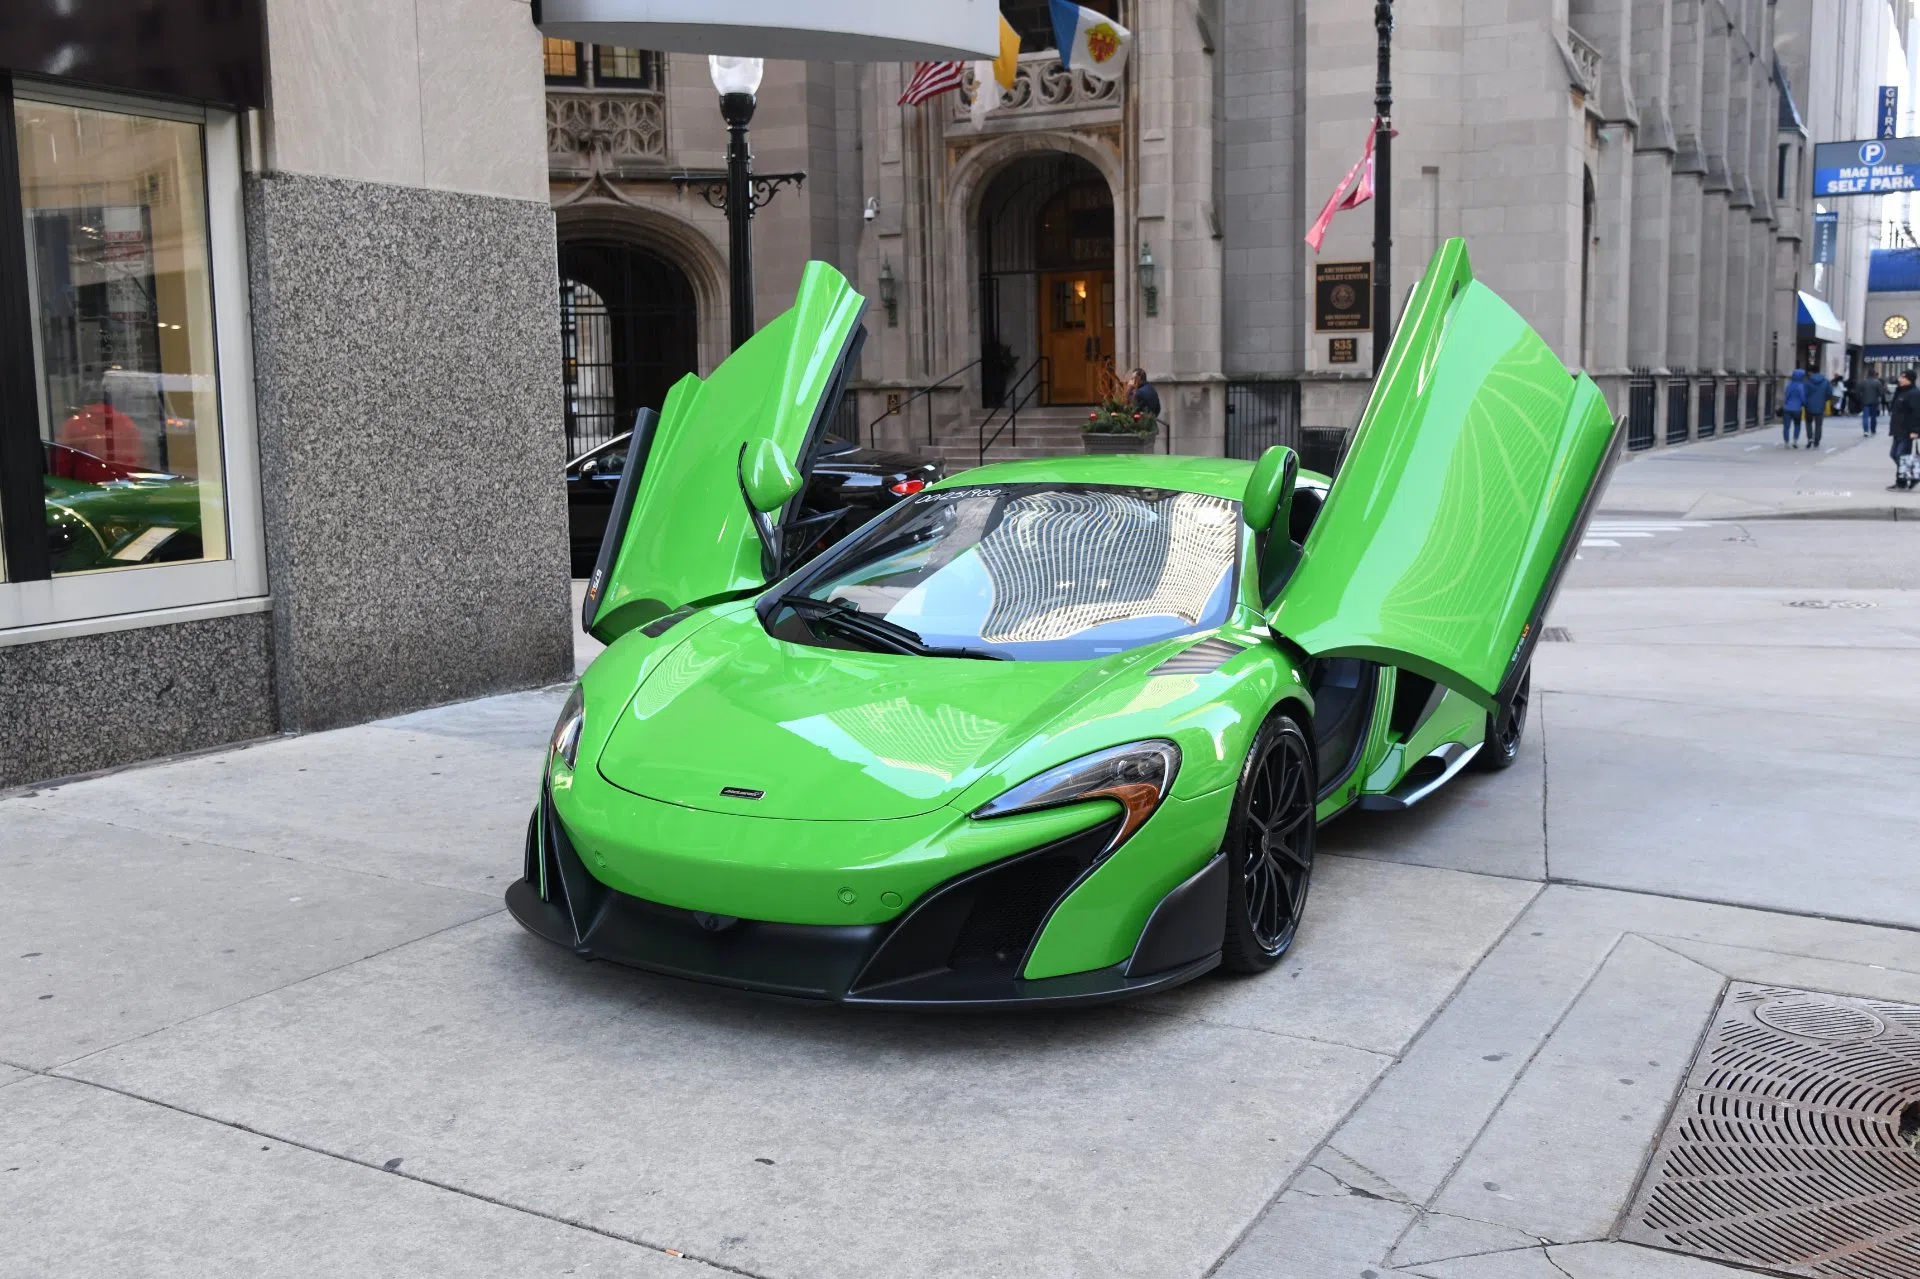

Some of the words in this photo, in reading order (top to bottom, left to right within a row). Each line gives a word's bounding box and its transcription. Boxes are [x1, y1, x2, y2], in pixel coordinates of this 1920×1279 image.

[1884, 87, 1895, 139] GHIRA
[1839, 167, 1869, 179] MAG
[1872, 164, 1904, 177] MILE
[1827, 179, 1867, 193] SELF
[1870, 175, 1915, 191] PARK
